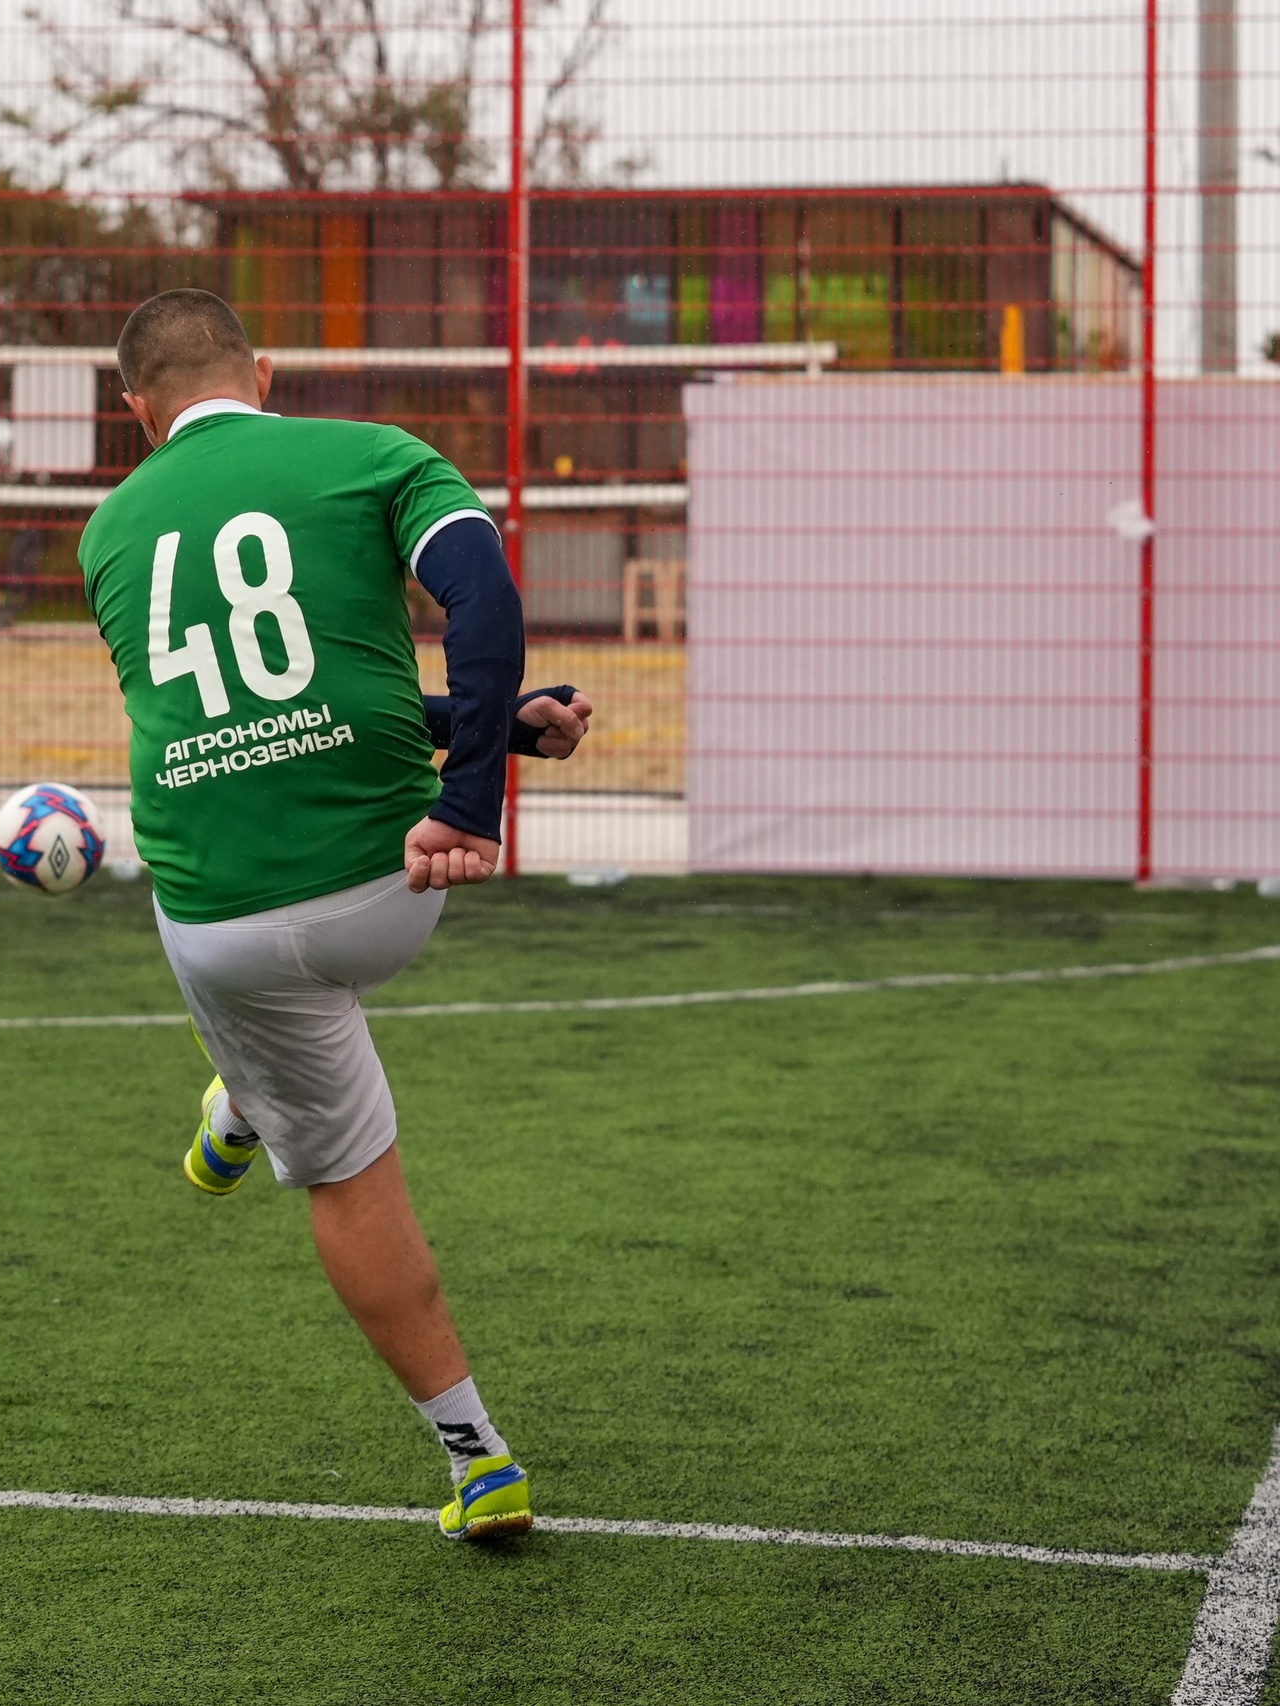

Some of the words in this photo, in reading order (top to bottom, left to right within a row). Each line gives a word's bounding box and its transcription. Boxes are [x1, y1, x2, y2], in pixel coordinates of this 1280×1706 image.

[148, 511, 316, 718] 48
[156, 724, 355, 789] ЧЕРНОЗЕМЬЯ
[165, 704, 332, 764] АГРОНОМЫ
